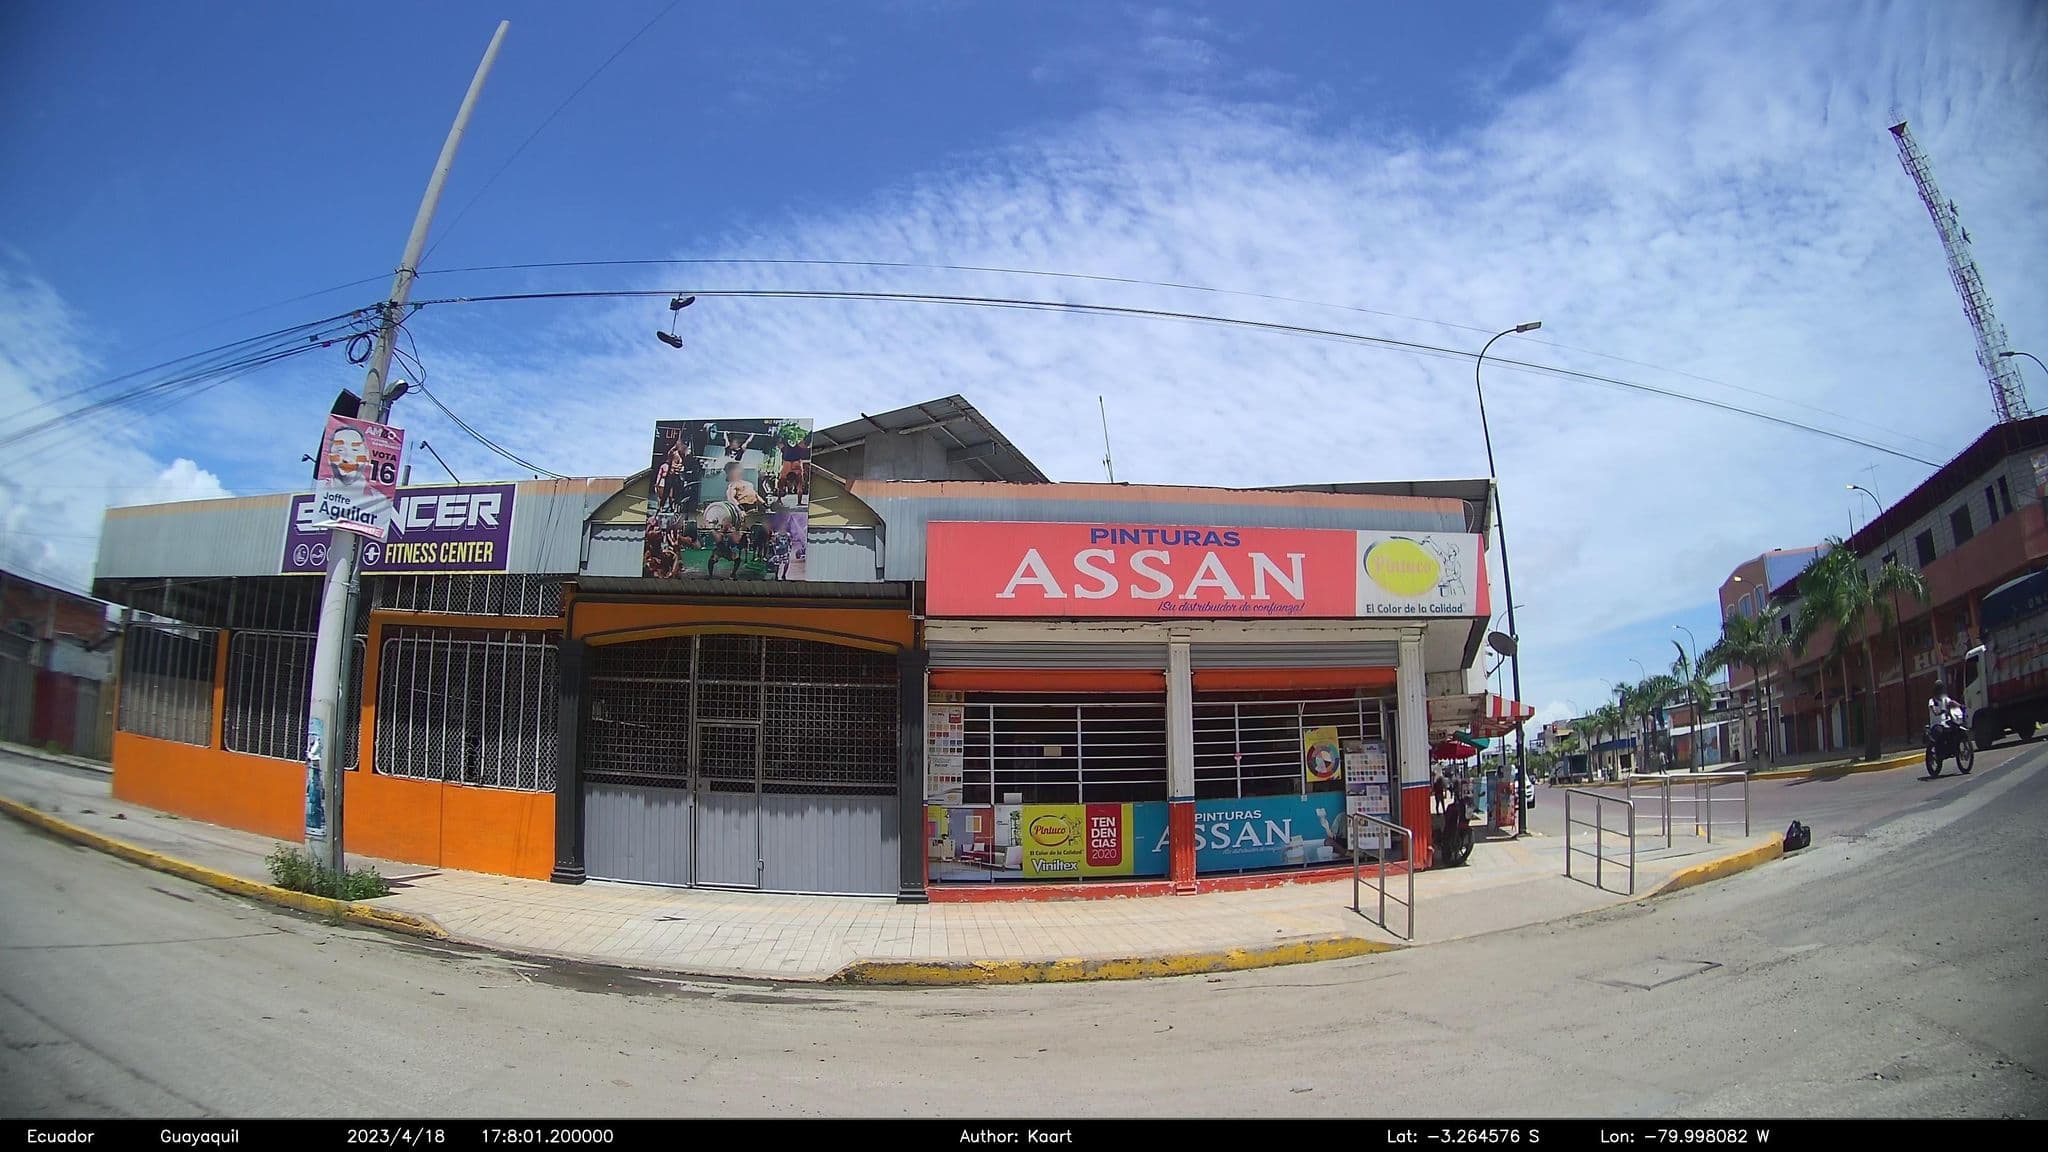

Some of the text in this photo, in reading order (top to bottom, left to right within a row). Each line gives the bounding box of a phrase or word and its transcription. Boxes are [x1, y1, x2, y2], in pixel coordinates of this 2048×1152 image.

[372, 450, 397, 462] VOTA
[369, 459, 396, 486] 16
[322, 492, 351, 505] Joffre
[319, 500, 378, 526] Aguilar
[1091, 527, 1241, 548] PINTURAS
[384, 541, 494, 564] FITNESS CENTER
[1373, 556, 1432, 575] Pintuco
[995, 548, 1305, 600] ASSAN
[1178, 601, 1237, 613] distribuidor
[1239, 602, 1251, 613] de
[1366, 604, 1464, 614] El Color de la Calidad
[1194, 809, 1262, 822] PINTURAS
[1091, 817, 1116, 828] TEN
[1033, 825, 1067, 836] Pintuco
[1091, 828, 1117, 839] DEN
[1091, 838, 1117, 849] CIAS
[1092, 848, 1117, 860] 2020
[1031, 858, 1079, 873] Viniltex
